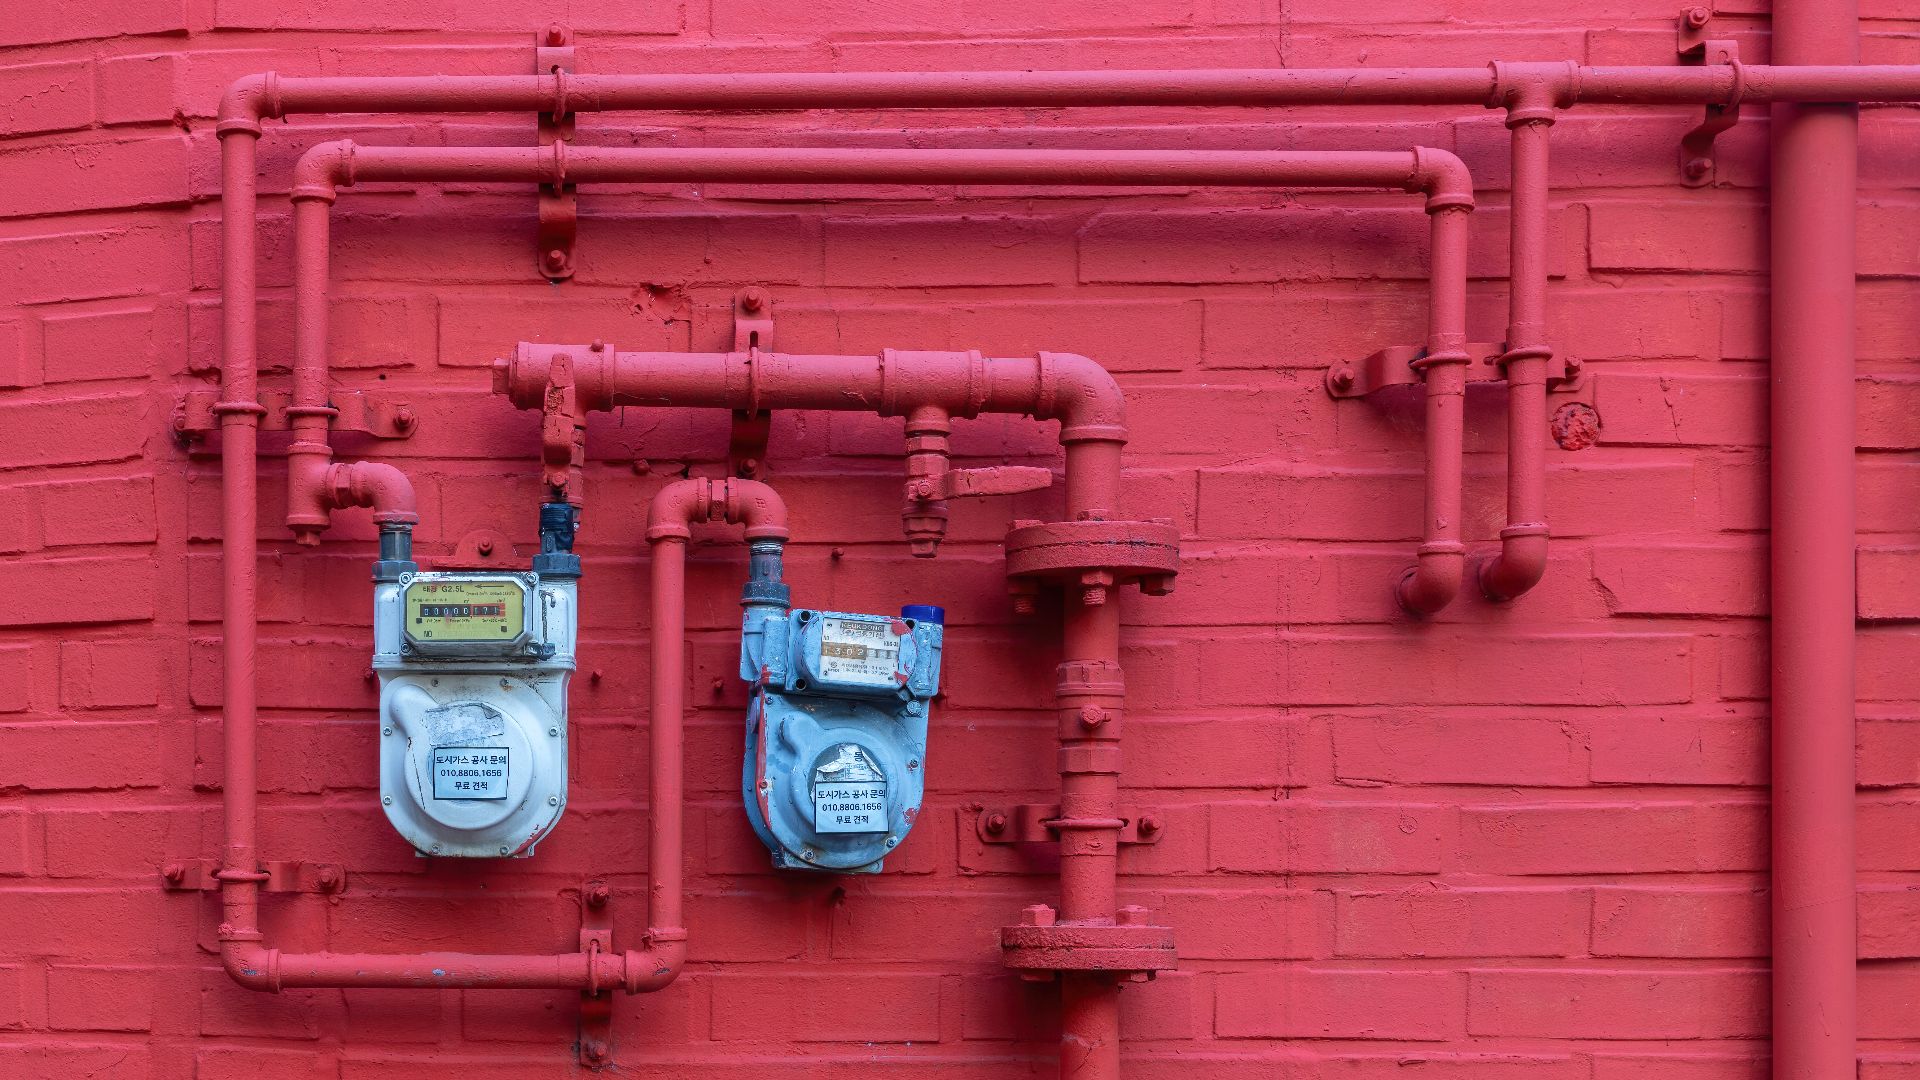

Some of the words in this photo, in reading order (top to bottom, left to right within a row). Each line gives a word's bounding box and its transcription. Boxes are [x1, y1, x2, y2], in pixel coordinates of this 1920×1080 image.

[441, 585, 465, 593] G2.5L
[436, 755, 470, 765] 도시가스
[471, 755, 488, 765] 공사
[490, 755, 507, 765] 문의
[440, 769, 502, 777] 010.8806.1656
[454, 781, 471, 791] 무료
[472, 781, 488, 791] 견적
[817, 790, 851, 800] 도시가스
[852, 789, 869, 799] 공사
[870, 789, 886, 799] 문의
[822, 803, 882, 812] 010.8806.1656
[836, 815, 852, 824] 무료
[853, 815, 869, 824] 견적
